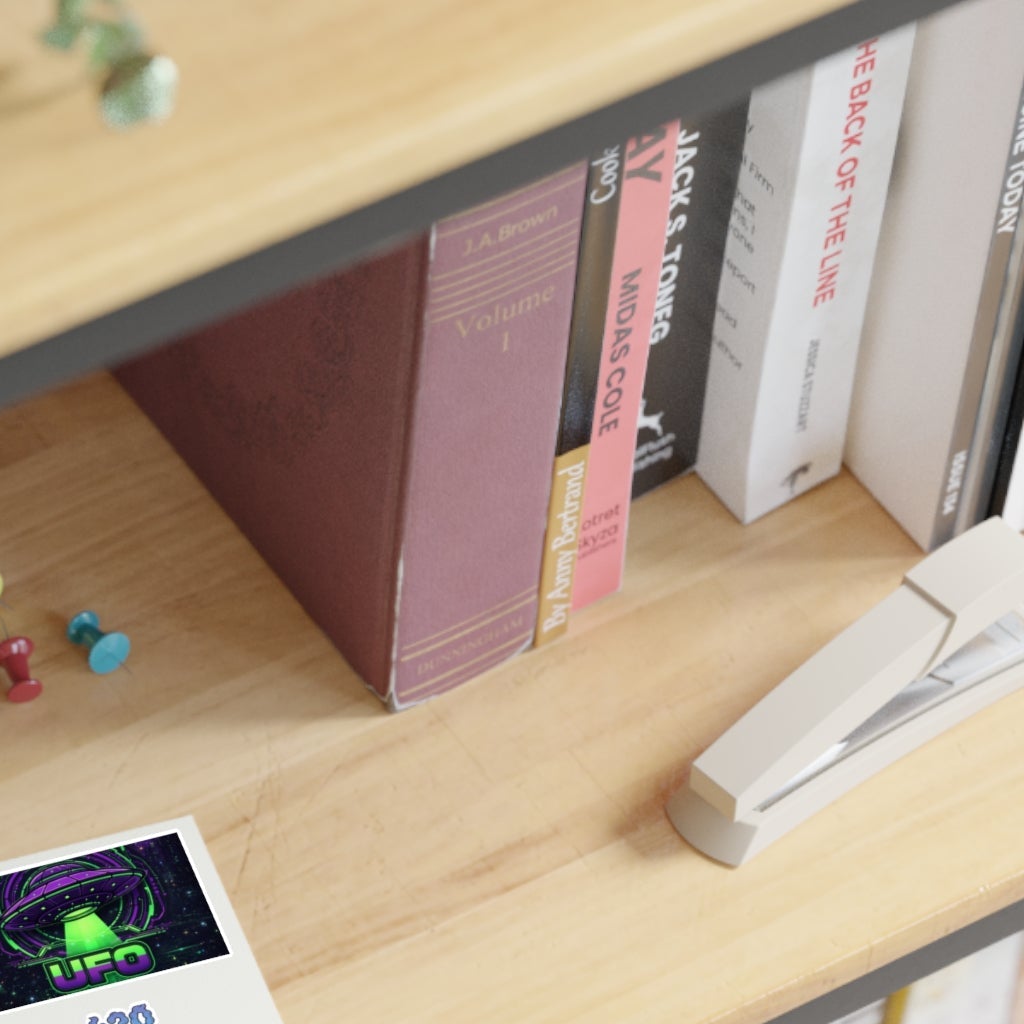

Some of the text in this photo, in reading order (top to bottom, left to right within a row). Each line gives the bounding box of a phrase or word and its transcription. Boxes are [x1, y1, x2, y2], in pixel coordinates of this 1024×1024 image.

[840, 79, 872, 155] BACK
[589, 144, 621, 205] Cook
[669, 128, 701, 212] JACK
[835, 156, 859, 192] OF
[824, 194, 853, 250] THE
[812, 249, 843, 308] LINE
[454, 285, 557, 338] Volume
[598, 267, 643, 438] MIDAS COLE
[550, 460, 586, 550] Bertrand
[542, 602, 572, 634] By
[46, 941, 154, 993] UFO
